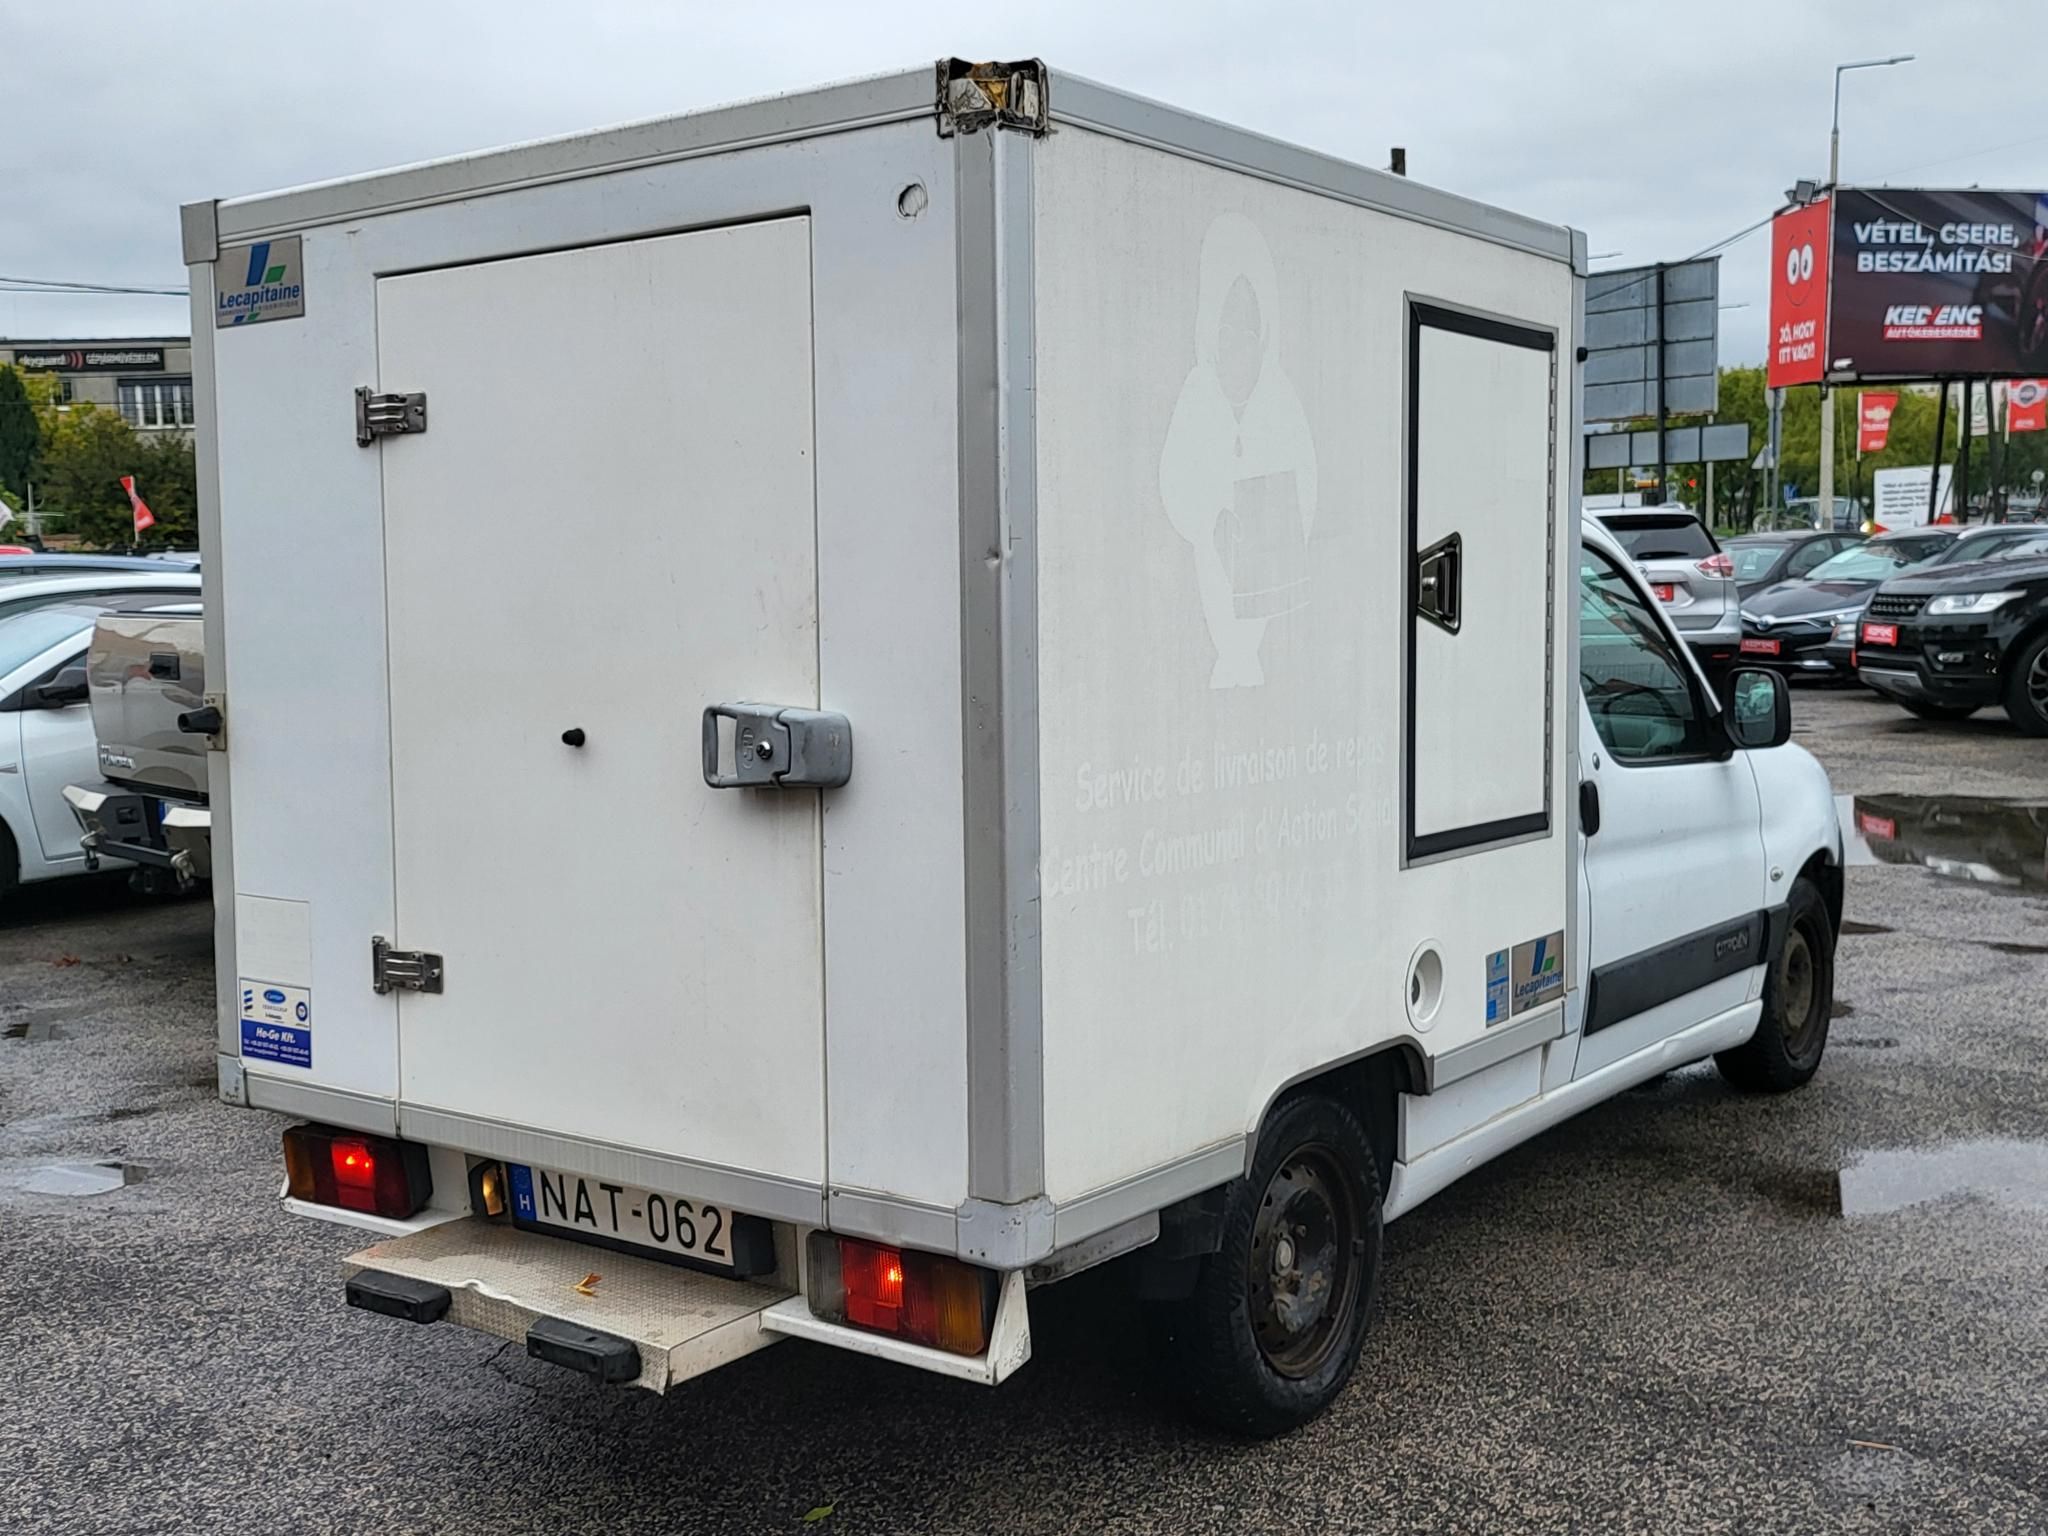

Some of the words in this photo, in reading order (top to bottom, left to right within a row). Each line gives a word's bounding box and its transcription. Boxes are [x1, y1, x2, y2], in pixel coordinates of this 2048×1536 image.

[1854, 217, 1935, 248] VÉTEL,
[1940, 223, 2020, 248] CSERE,
[1857, 248, 2012, 273] BESZÁMÍTÁS!
[219, 283, 300, 312] Lecapitaine
[1075, 752, 1167, 814] Service
[1176, 743, 1205, 796] de
[1213, 736, 1298, 789] livraison
[1306, 726, 1329, 775] de
[1139, 808, 1246, 878] Communal
[1514, 969, 1564, 999] Lecapitaine
[519, 1193, 531, 1212] H
[539, 1169, 726, 1257] NAT-062
